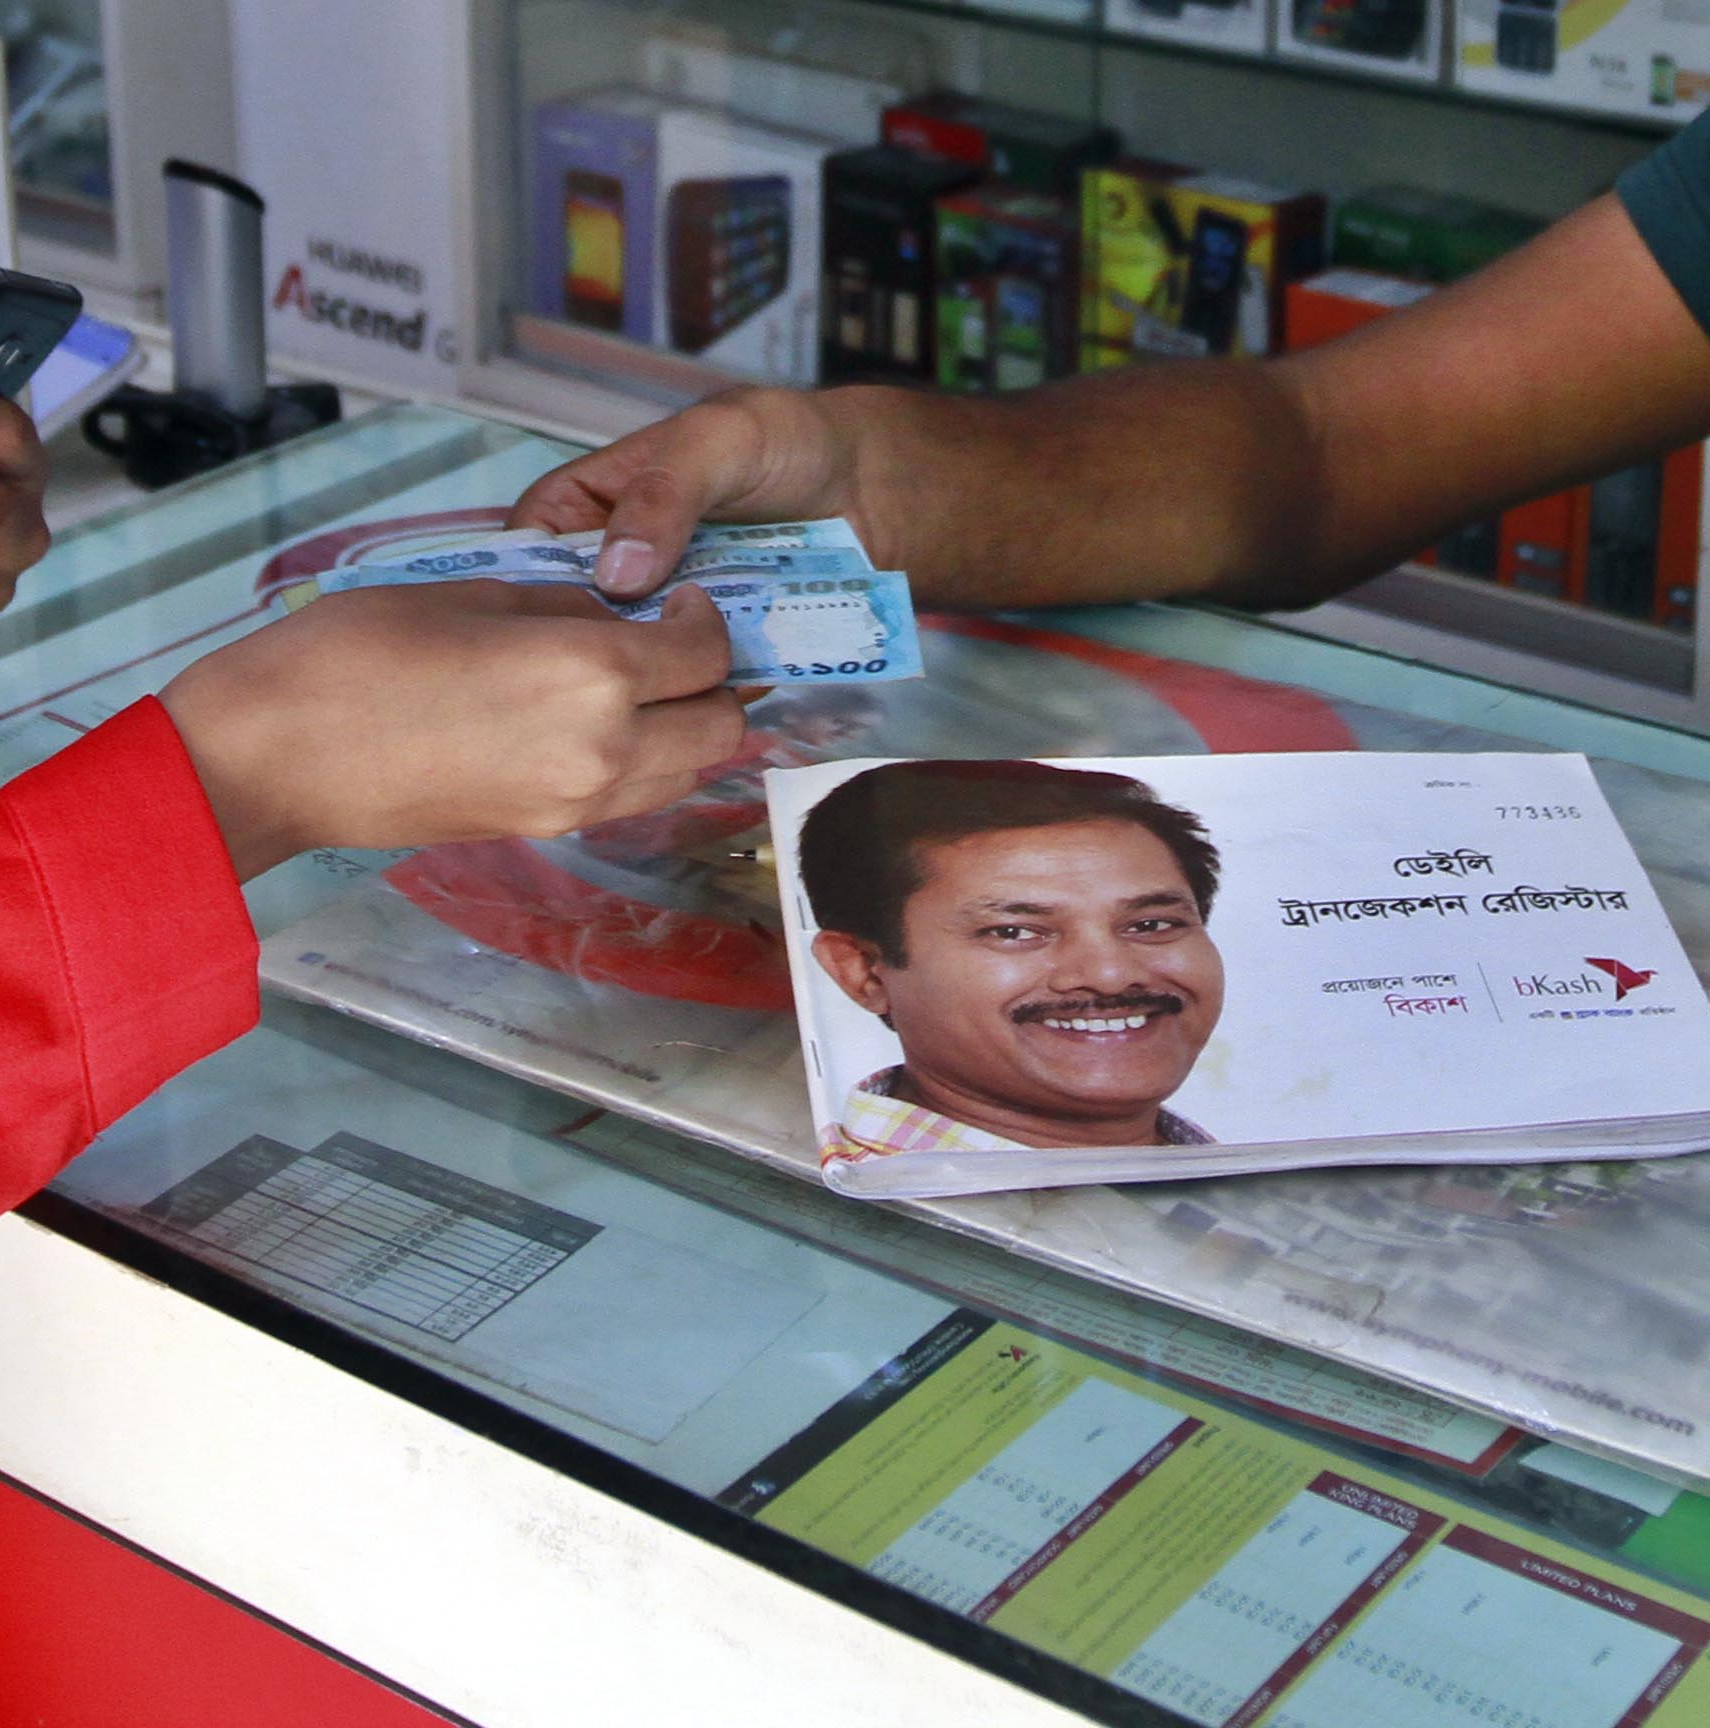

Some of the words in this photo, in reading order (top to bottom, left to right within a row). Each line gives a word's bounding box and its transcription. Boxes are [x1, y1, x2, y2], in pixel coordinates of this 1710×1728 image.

[308, 237, 426, 295] HUAWEI
[273, 263, 427, 353] Ascend
[779, 578, 873, 596] 100
[1393, 847, 1496, 878] ডেইলি
[1279, 894, 1469, 929] ট্রানজেকশন
[1482, 884, 1630, 917] রেজিস্টার
[1321, 974, 1405, 995] প্রয়োজনে
[1411, 972, 1459, 990] পাশে
[1514, 974, 1603, 998] bKash
[1382, 993, 1470, 1020] বিকাশ
[1519, 1558, 1582, 1590] LIMITED
[1583, 1580, 1639, 1613] PLANS
